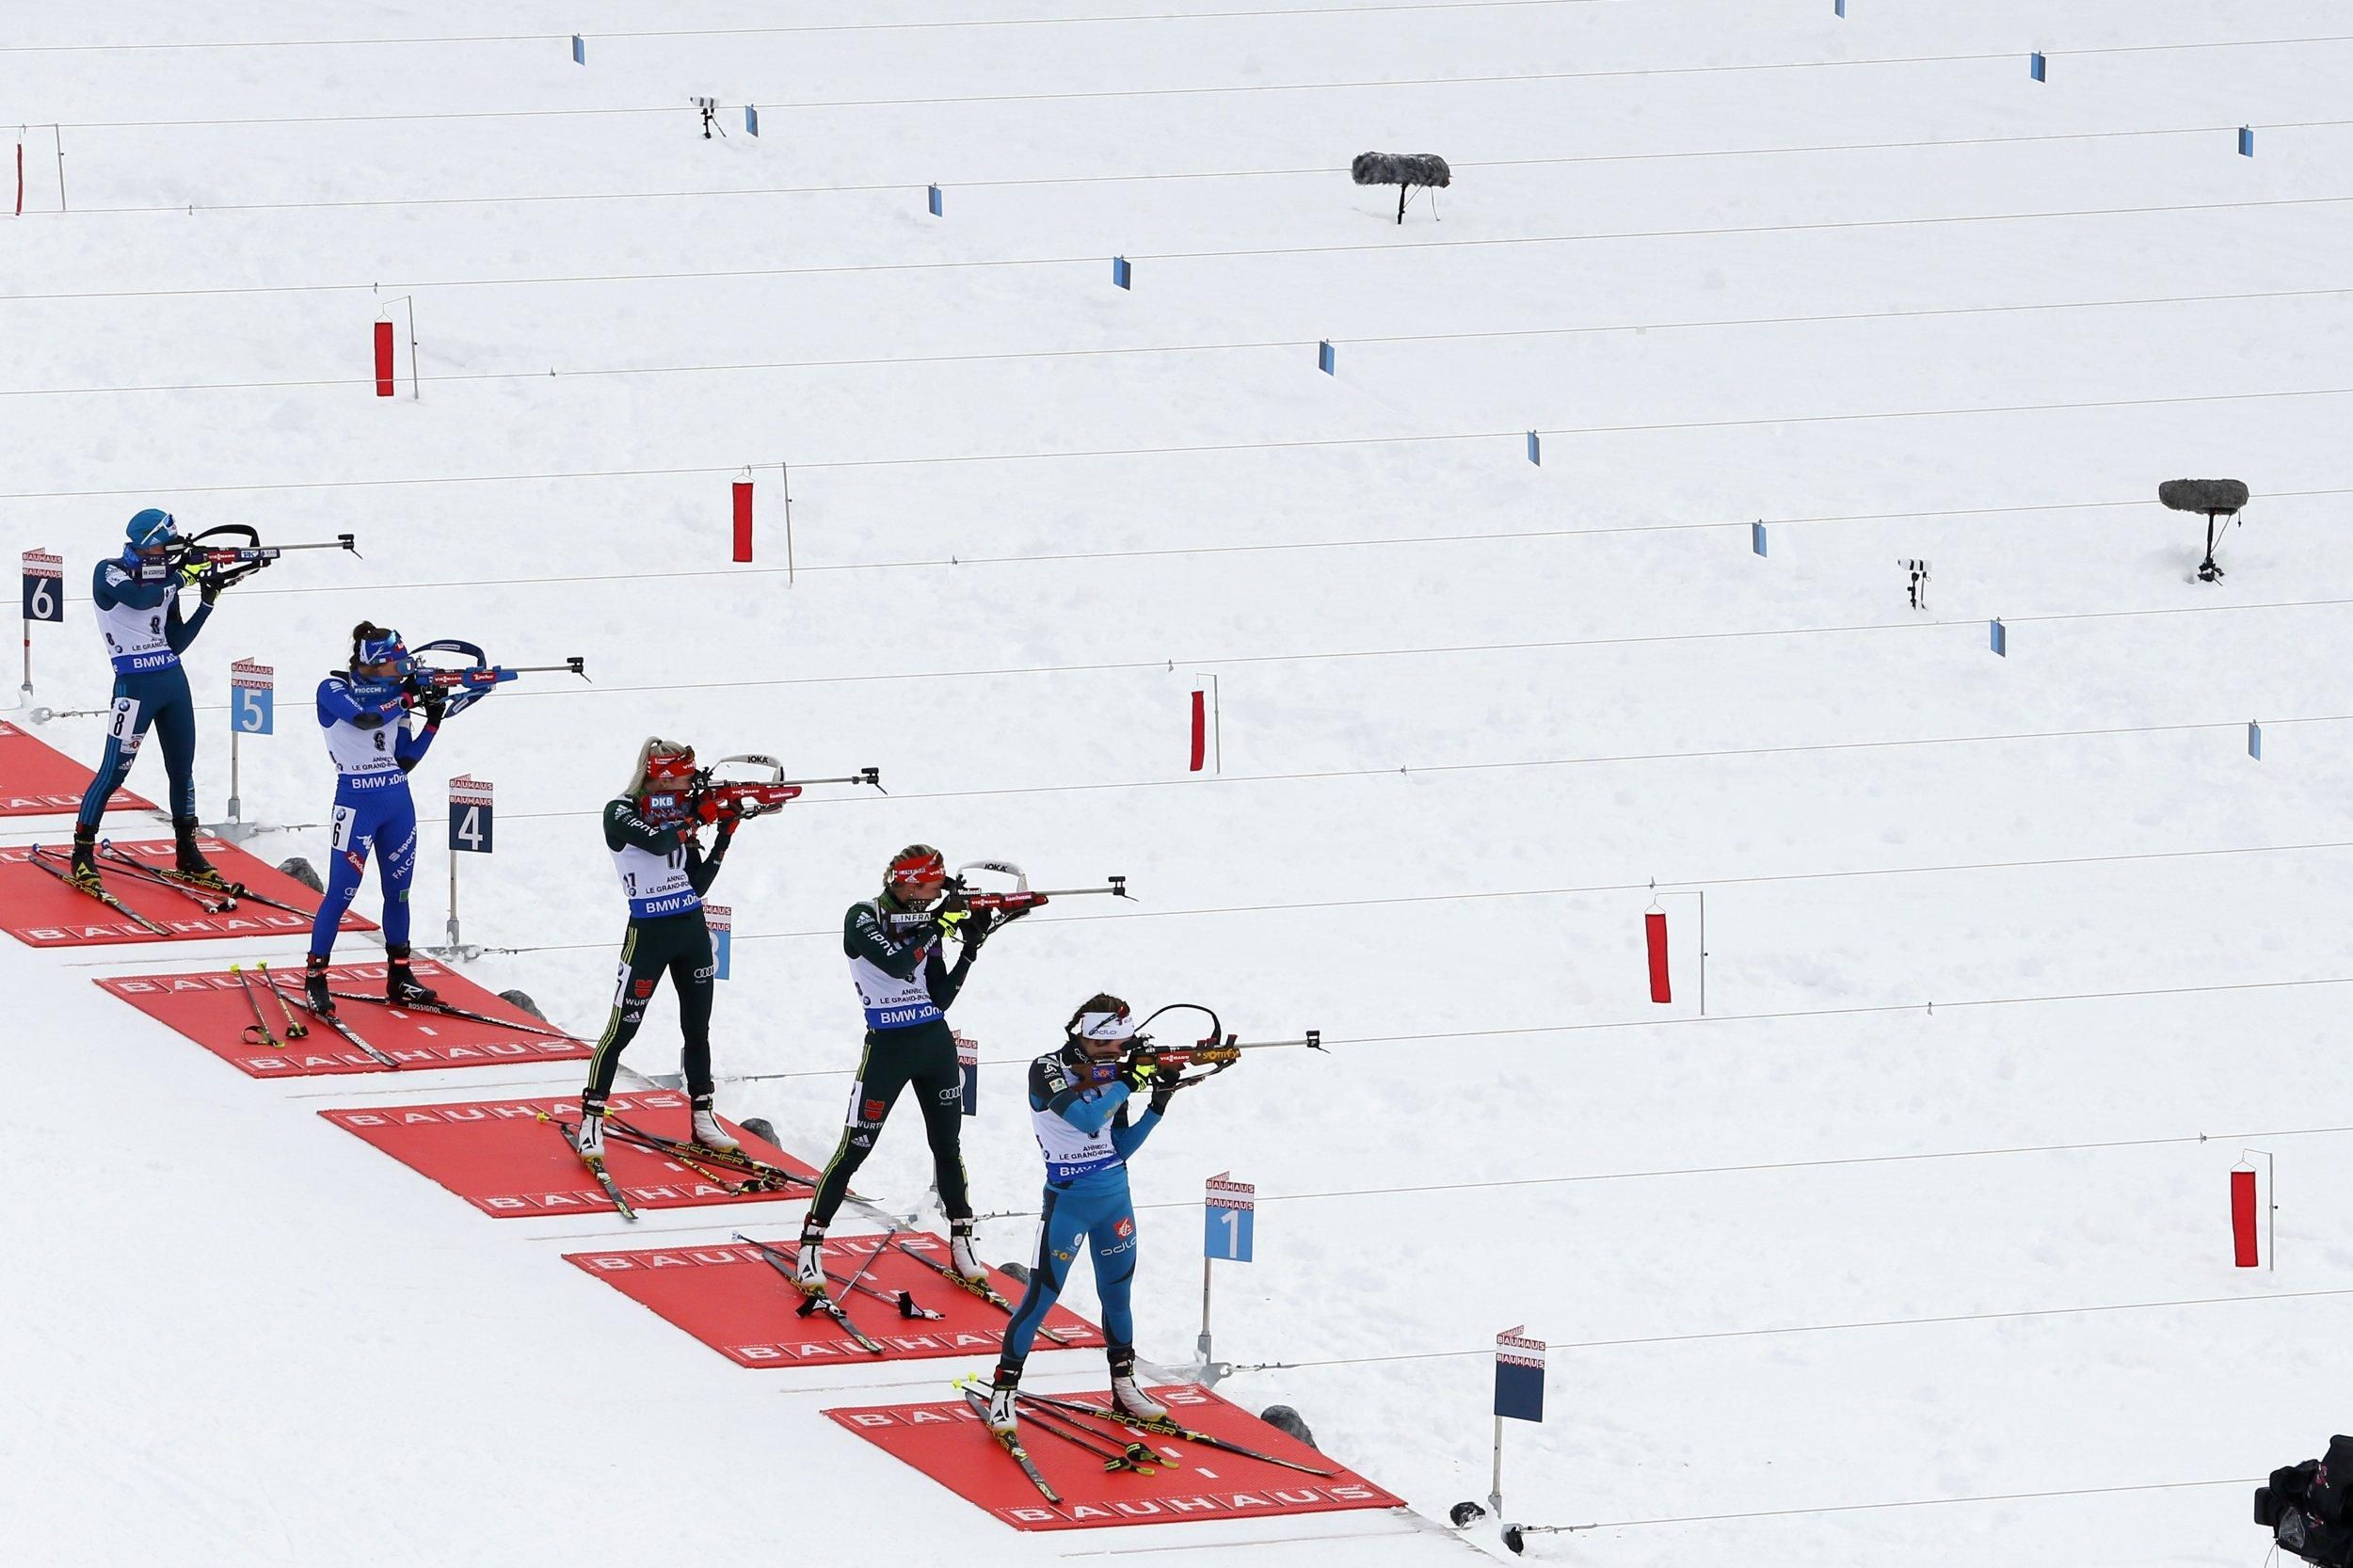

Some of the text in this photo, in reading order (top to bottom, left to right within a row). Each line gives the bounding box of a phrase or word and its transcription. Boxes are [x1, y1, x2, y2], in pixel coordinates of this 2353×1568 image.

[23, 552, 62, 564] BAUHAUS
[23, 568, 62, 578] BAUHAUS
[31, 578, 54, 619] 6
[134, 655, 166, 668] BMW
[232, 664, 273, 675] BAUHAUS
[232, 679, 273, 690] BAUHAUS
[242, 689, 264, 731] 5
[113, 712, 125, 737] 8
[747, 755, 769, 764] JOKA
[352, 776, 386, 789] BMW
[449, 779, 493, 791] BAUHAUS
[449, 795, 493, 807] BAUHAUS
[651, 796, 674, 808] DKB
[457, 806, 484, 851] 4
[627, 817, 660, 837] Audi
[332, 822, 341, 847] 6
[984, 863, 1007, 872] JOKA
[159, 870, 222, 890] FISCHER
[646, 897, 680, 914] BMW
[867, 930, 898, 957] Audi
[408, 1002, 441, 1014] ROSSIGNOL
[880, 1008, 916, 1024] BMW
[1202, 1048, 1238, 1060] somfy
[676, 1142, 744, 1166] FISCHER
[1206, 1180, 1255, 1192] BAUHAUS
[1206, 1198, 1254, 1210] BAUHAUS
[1220, 1209, 1239, 1258] 1
[941, 1271, 985, 1299] FISCHER
[1497, 1336, 1545, 1350] BAUHAUS
[1497, 1353, 1545, 1368] BAUHAUS
[1094, 1410, 1176, 1436] FISCHER
[1012, 1486, 1374, 1522] BAUHAUS
